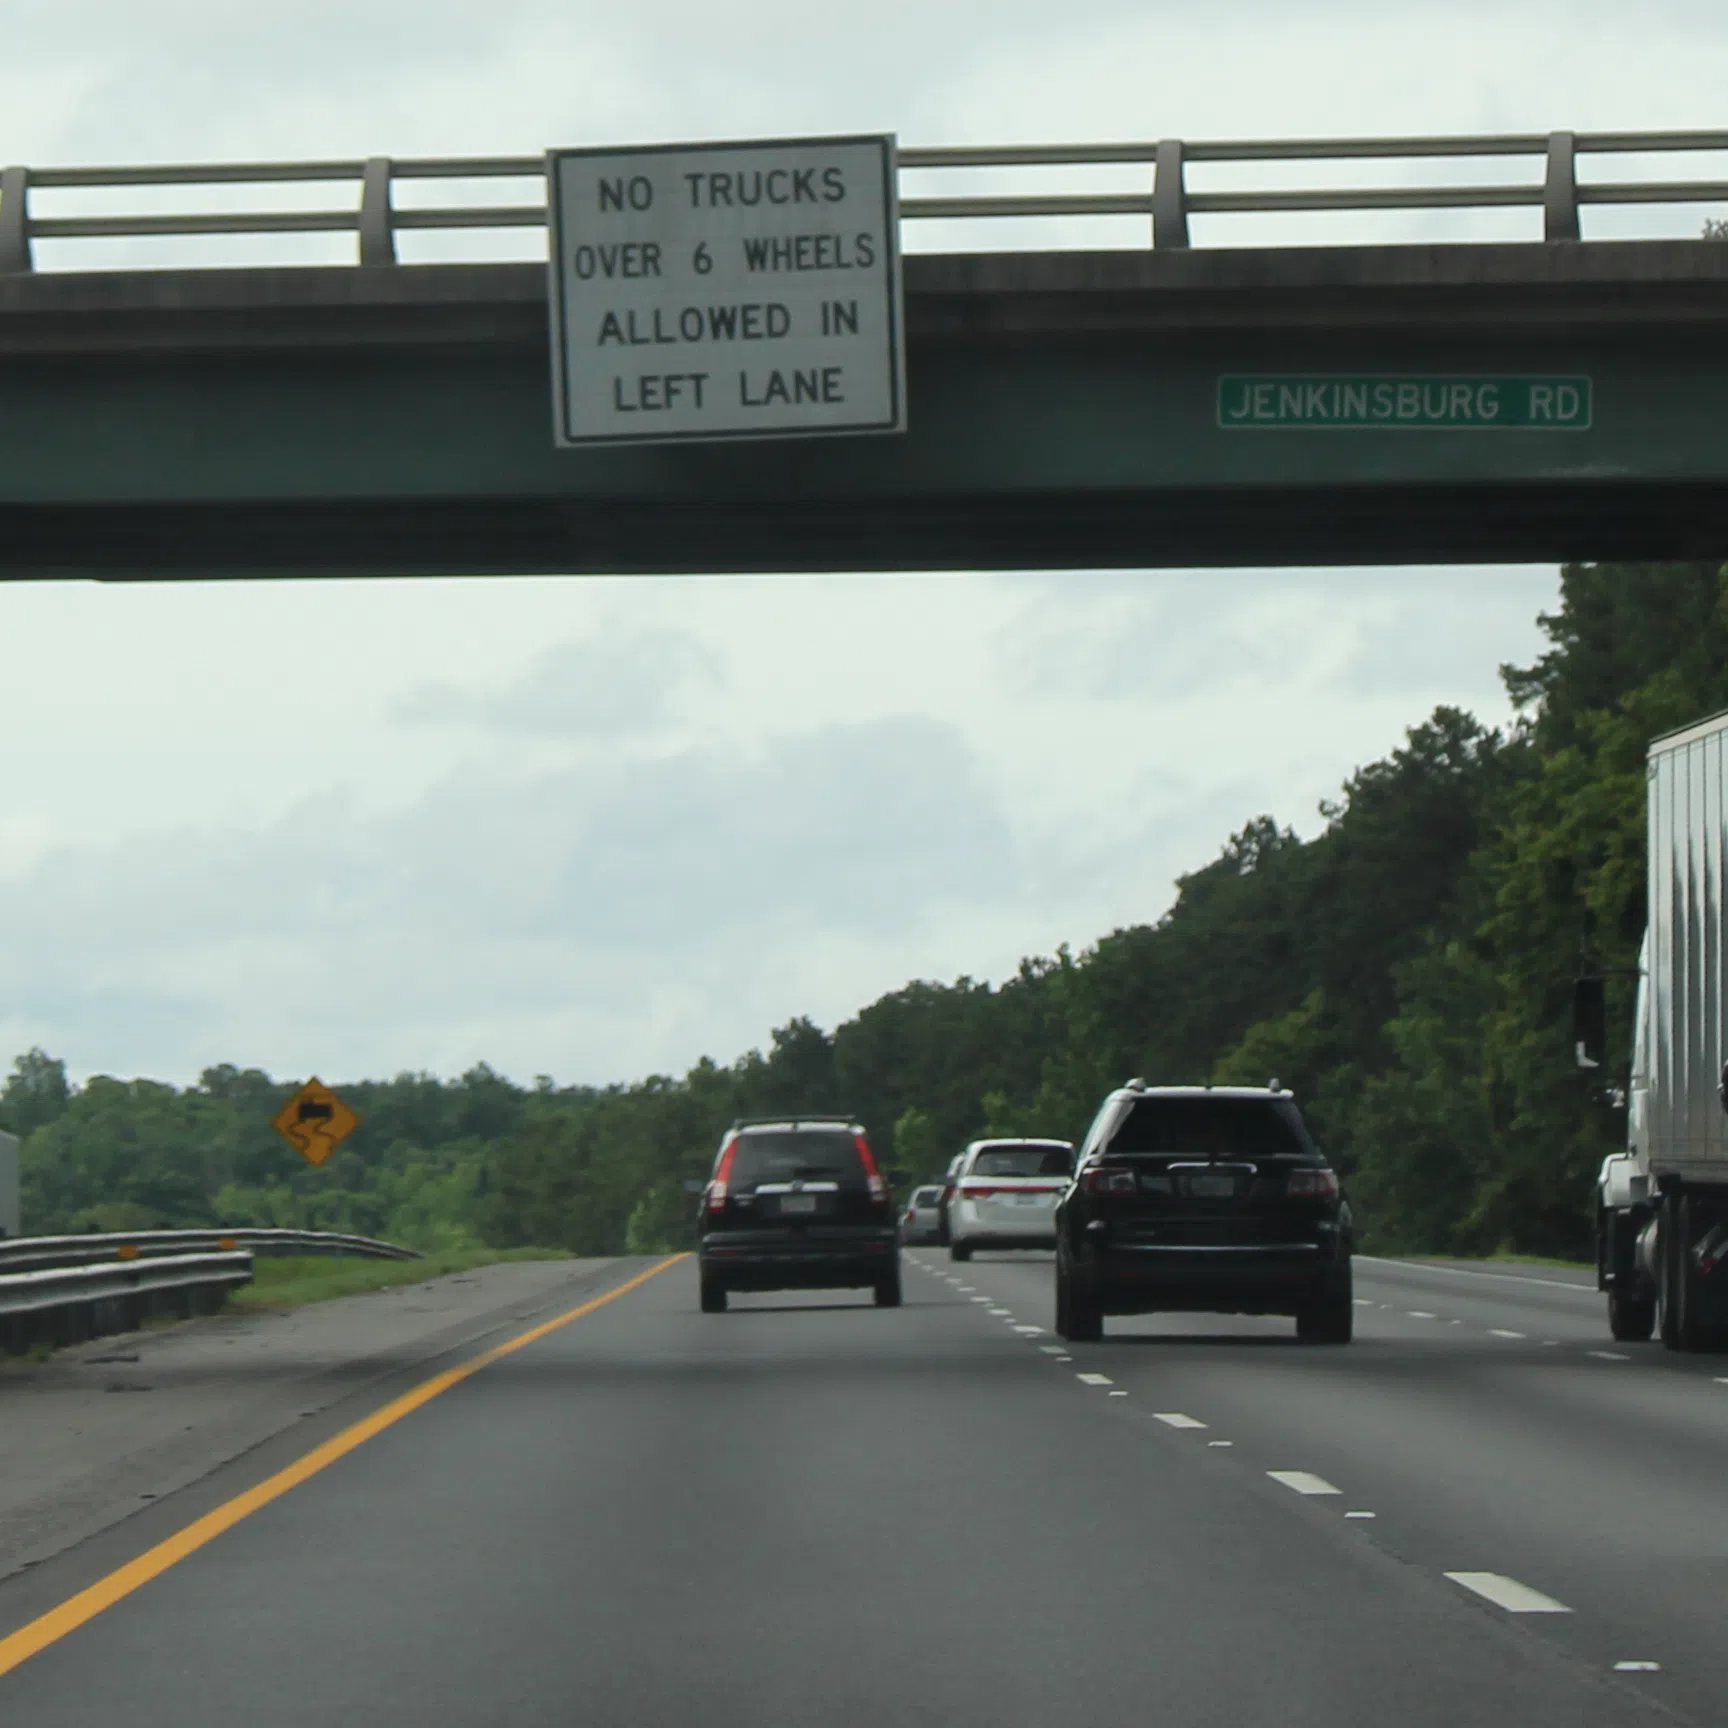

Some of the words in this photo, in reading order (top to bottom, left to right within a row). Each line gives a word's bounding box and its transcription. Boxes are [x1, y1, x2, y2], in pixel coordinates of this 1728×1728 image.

[598, 176, 653, 212] NO
[684, 168, 846, 208] TRUCKS
[575, 243, 662, 280] OVER
[693, 241, 713, 275] 6
[743, 233, 874, 273] WHEELS
[597, 303, 791, 346] ALLOWED
[821, 300, 859, 336] IN
[615, 374, 709, 411] LEFT
[740, 368, 844, 406] LANE
[1228, 383, 1500, 419] JENKINSBURG
[1529, 385, 1580, 420] RD
